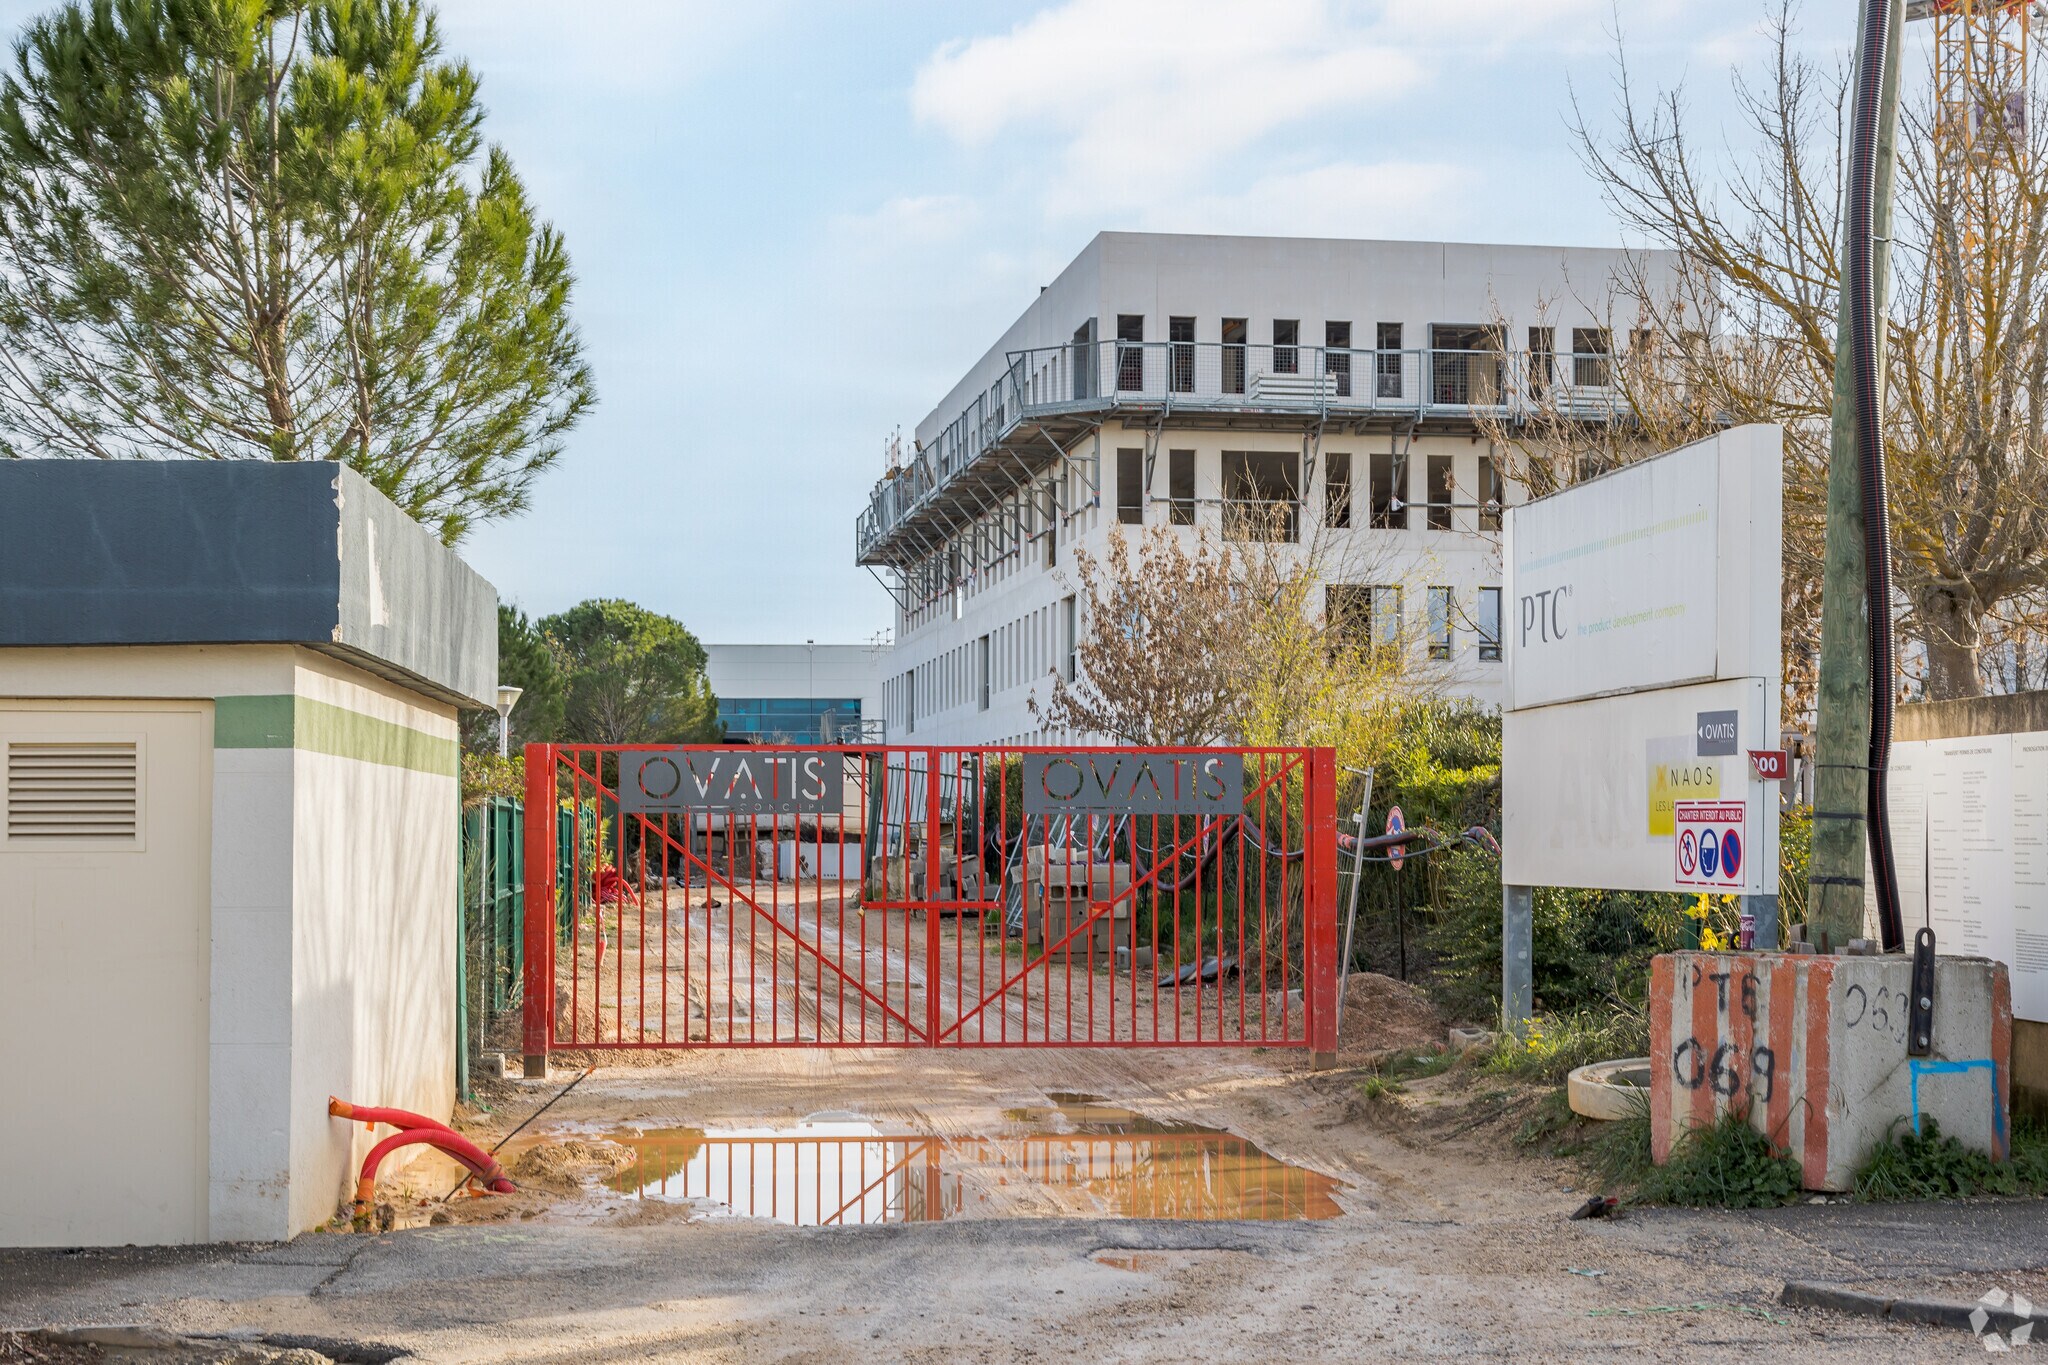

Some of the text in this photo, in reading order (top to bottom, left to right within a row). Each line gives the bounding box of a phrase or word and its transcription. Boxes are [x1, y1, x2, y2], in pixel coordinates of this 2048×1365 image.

[1588, 617, 1611, 637] product
[1613, 608, 1653, 629] development
[1655, 603, 1686, 619] company
[1705, 723, 1735, 740] OVATIS
[638, 756, 826, 800] OVATIS
[1041, 757, 1226, 800] OVATIS
[1671, 766, 1712, 787] NAOS
[1655, 801, 1666, 812] LES
[1679, 810, 1742, 820] CHANTIER INTERDIT AU PUBLIC
[1674, 1036, 1775, 1103] 069
